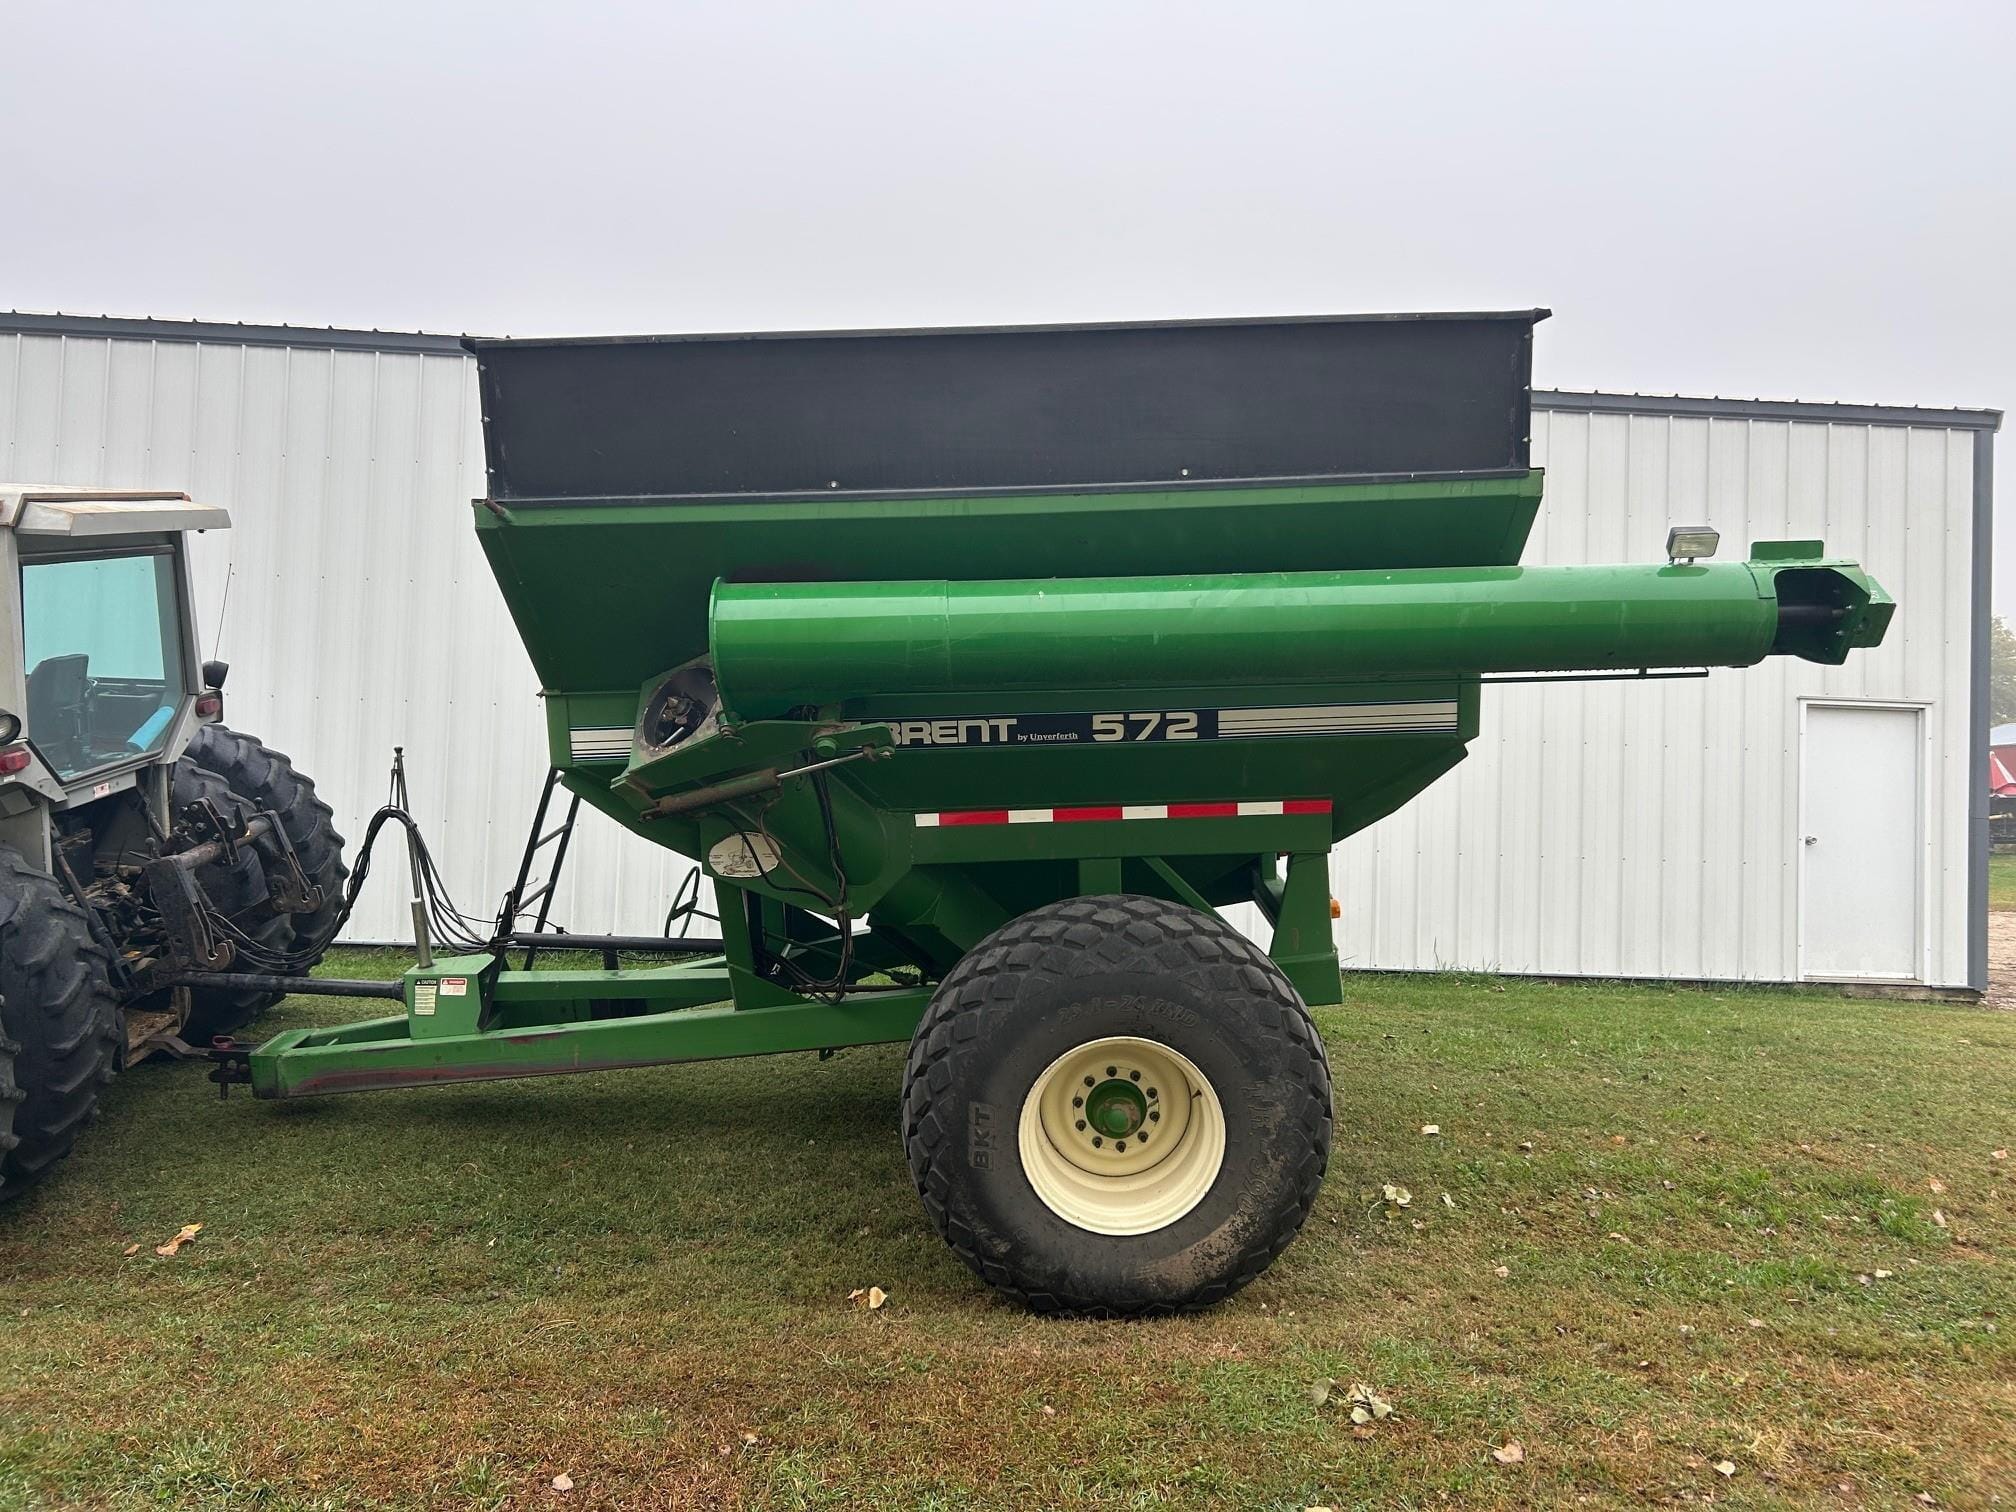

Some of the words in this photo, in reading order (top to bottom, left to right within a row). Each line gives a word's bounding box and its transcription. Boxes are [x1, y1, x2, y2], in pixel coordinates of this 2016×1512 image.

[1017, 733, 1029, 743] by
[1029, 732, 1079, 742] Unverferth
[1091, 711, 1199, 742] 572
[973, 1104, 992, 1169] BKT
